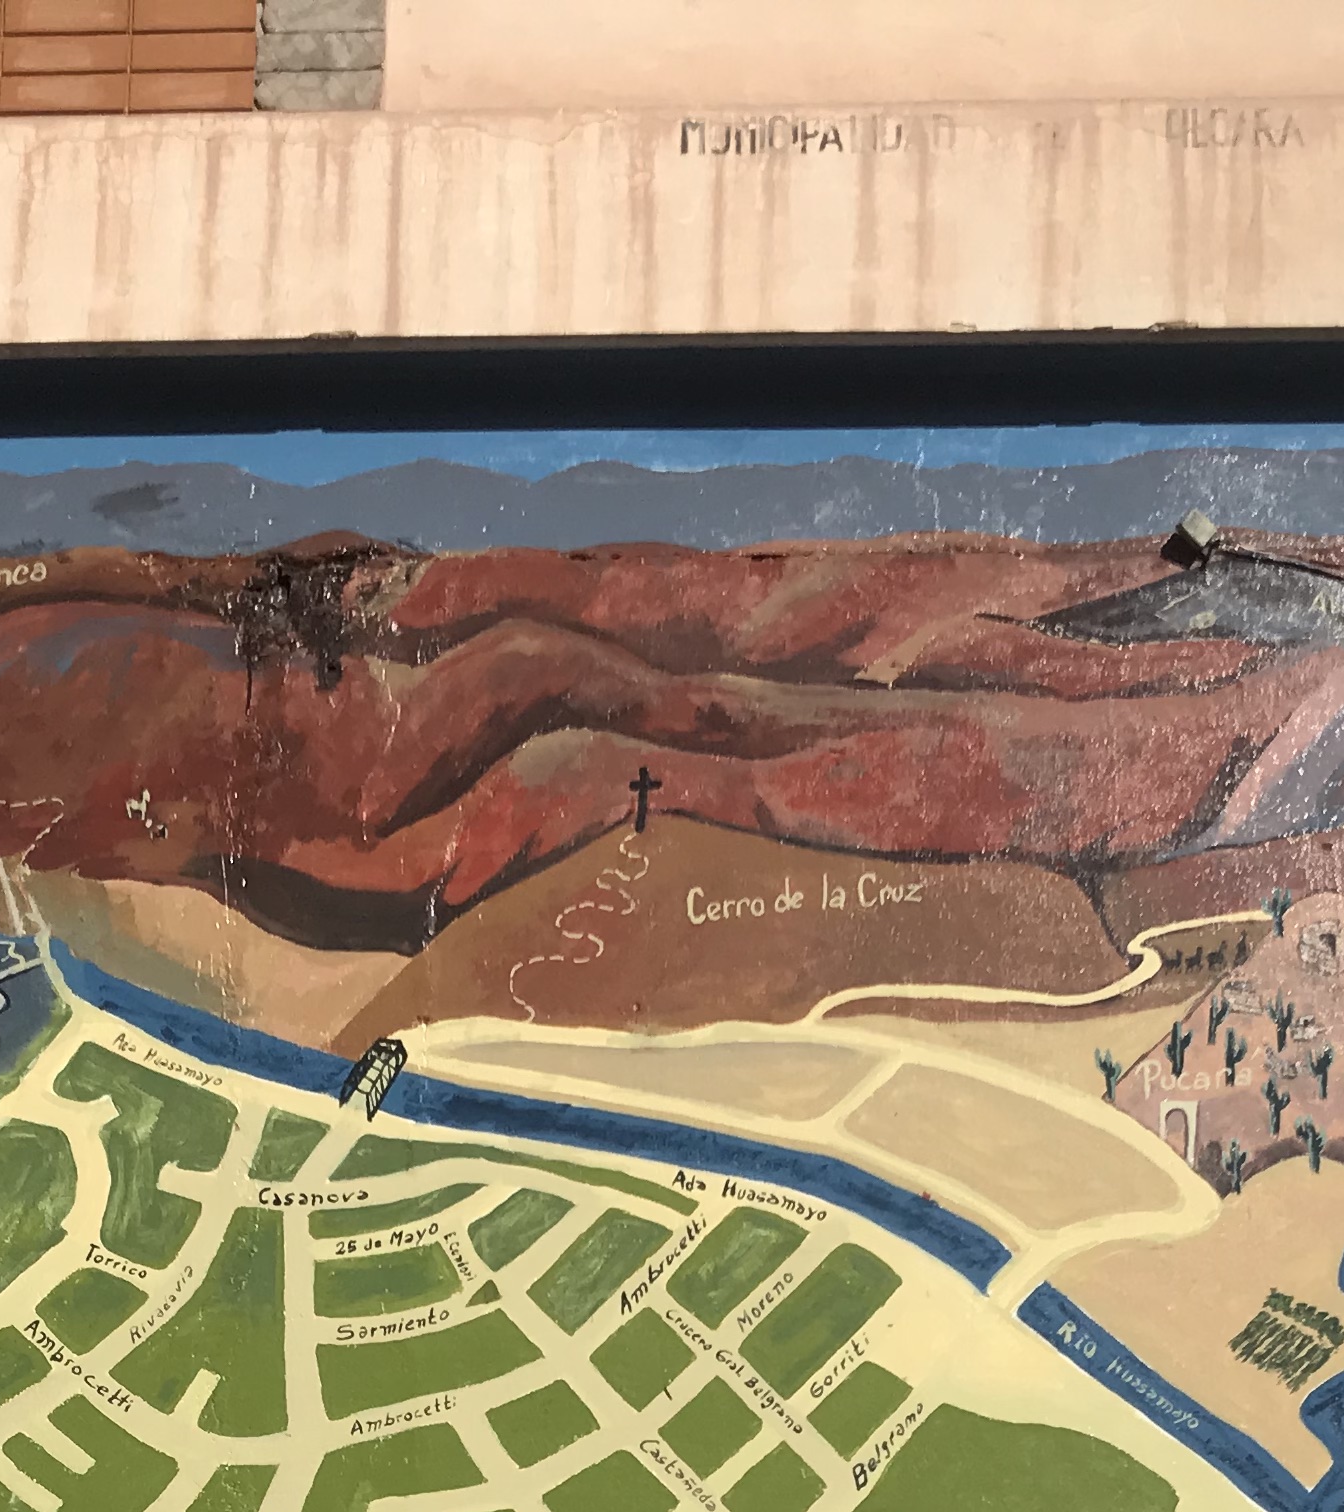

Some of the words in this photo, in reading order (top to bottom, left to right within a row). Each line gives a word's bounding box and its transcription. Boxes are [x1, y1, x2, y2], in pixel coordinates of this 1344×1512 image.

[686, 886, 766, 925] Cerro
[774, 876, 804, 914] de
[821, 875, 846, 911] la
[857, 871, 924, 908] Cruz
[258, 1186, 370, 1208] Casanova
[671, 1170, 707, 1193] Ada
[721, 1179, 828, 1222] Huasamayo
[84, 1243, 149, 1282] Torrico
[335, 1240, 357, 1256] 25
[363, 1236, 383, 1253] de
[389, 1222, 440, 1247] Mayo
[619, 1213, 708, 1316] Ambrocetti
[128, 1264, 195, 1345] Rivadavia
[335, 1307, 451, 1341] Sarmiento
[737, 1271, 794, 1334] Moreno
[22, 1319, 133, 1413] Ambrocetti
[809, 1331, 870, 1400] Gorriti
[1105, 1353, 1200, 1431] Huasamayo
[350, 1395, 457, 1436] Ambrocetti
[742, 1375, 804, 1435] Belgrano
[638, 1439, 717, 1512] Castañeda
